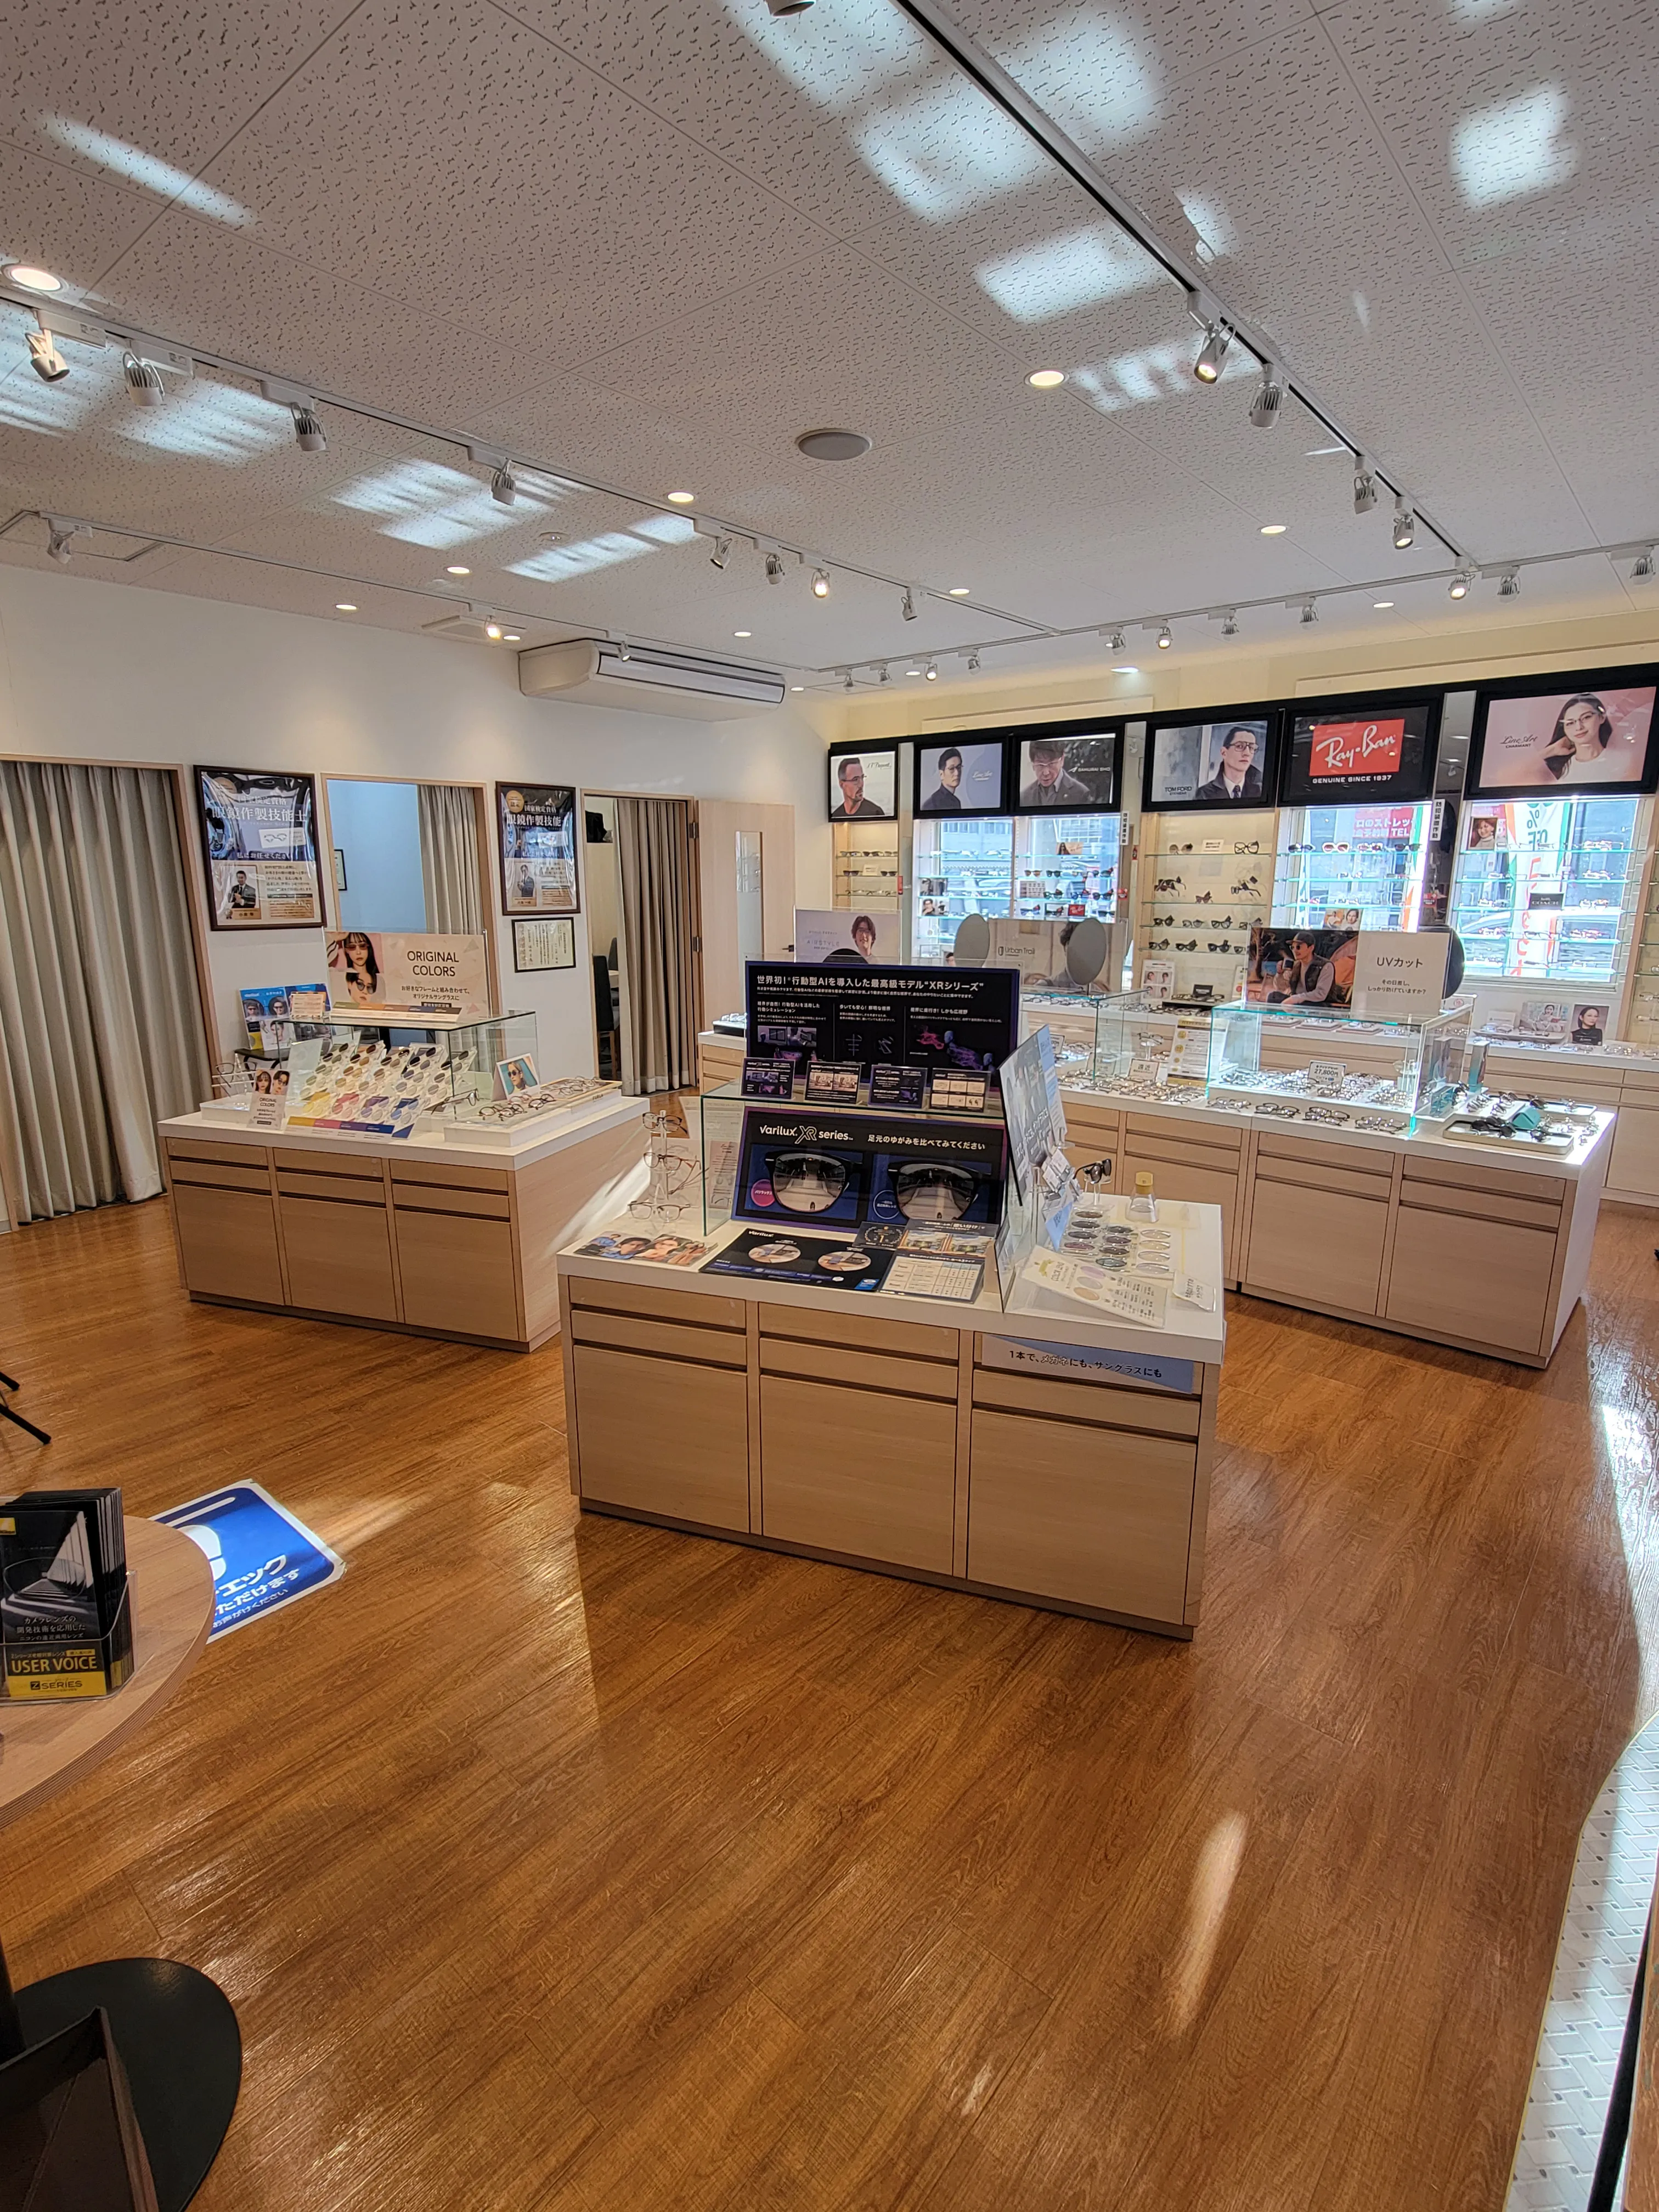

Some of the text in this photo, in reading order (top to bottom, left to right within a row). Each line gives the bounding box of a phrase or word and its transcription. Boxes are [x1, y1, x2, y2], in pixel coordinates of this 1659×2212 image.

[1316, 725, 1395, 768] Ray-Ban
[212, 807, 307, 822] 眼鏡作製技能士
[506, 814, 562, 827] 眼鏡作製技能
[1391, 828, 1410, 836] TEL
[407, 951, 459, 963] ORIGINAL
[1005, 947, 1035, 955] Urban Trail
[1376, 957, 1423, 968] UVカット
[413, 965, 455, 977] COLORS
[401, 985, 470, 995] お好きなフレームと組み合わせて、
[795, 1125, 817, 1144] XR
[819, 1130, 849, 1141] series
[867, 1134, 986, 1150] 足元のゆがみを比べてみてください
[1009, 1350, 1162, 1378] 1本で、メガネにも、サングラスにも
[215, 1554, 287, 1597] エック
[215, 1568, 300, 1617] ただけます
[24, 1615, 77, 1624] カメラレンズの
[16, 1623, 87, 1634] 開発技術を応用した
[12, 1656, 98, 1673] USER VOICE
[41, 1680, 83, 1690] SERIES
